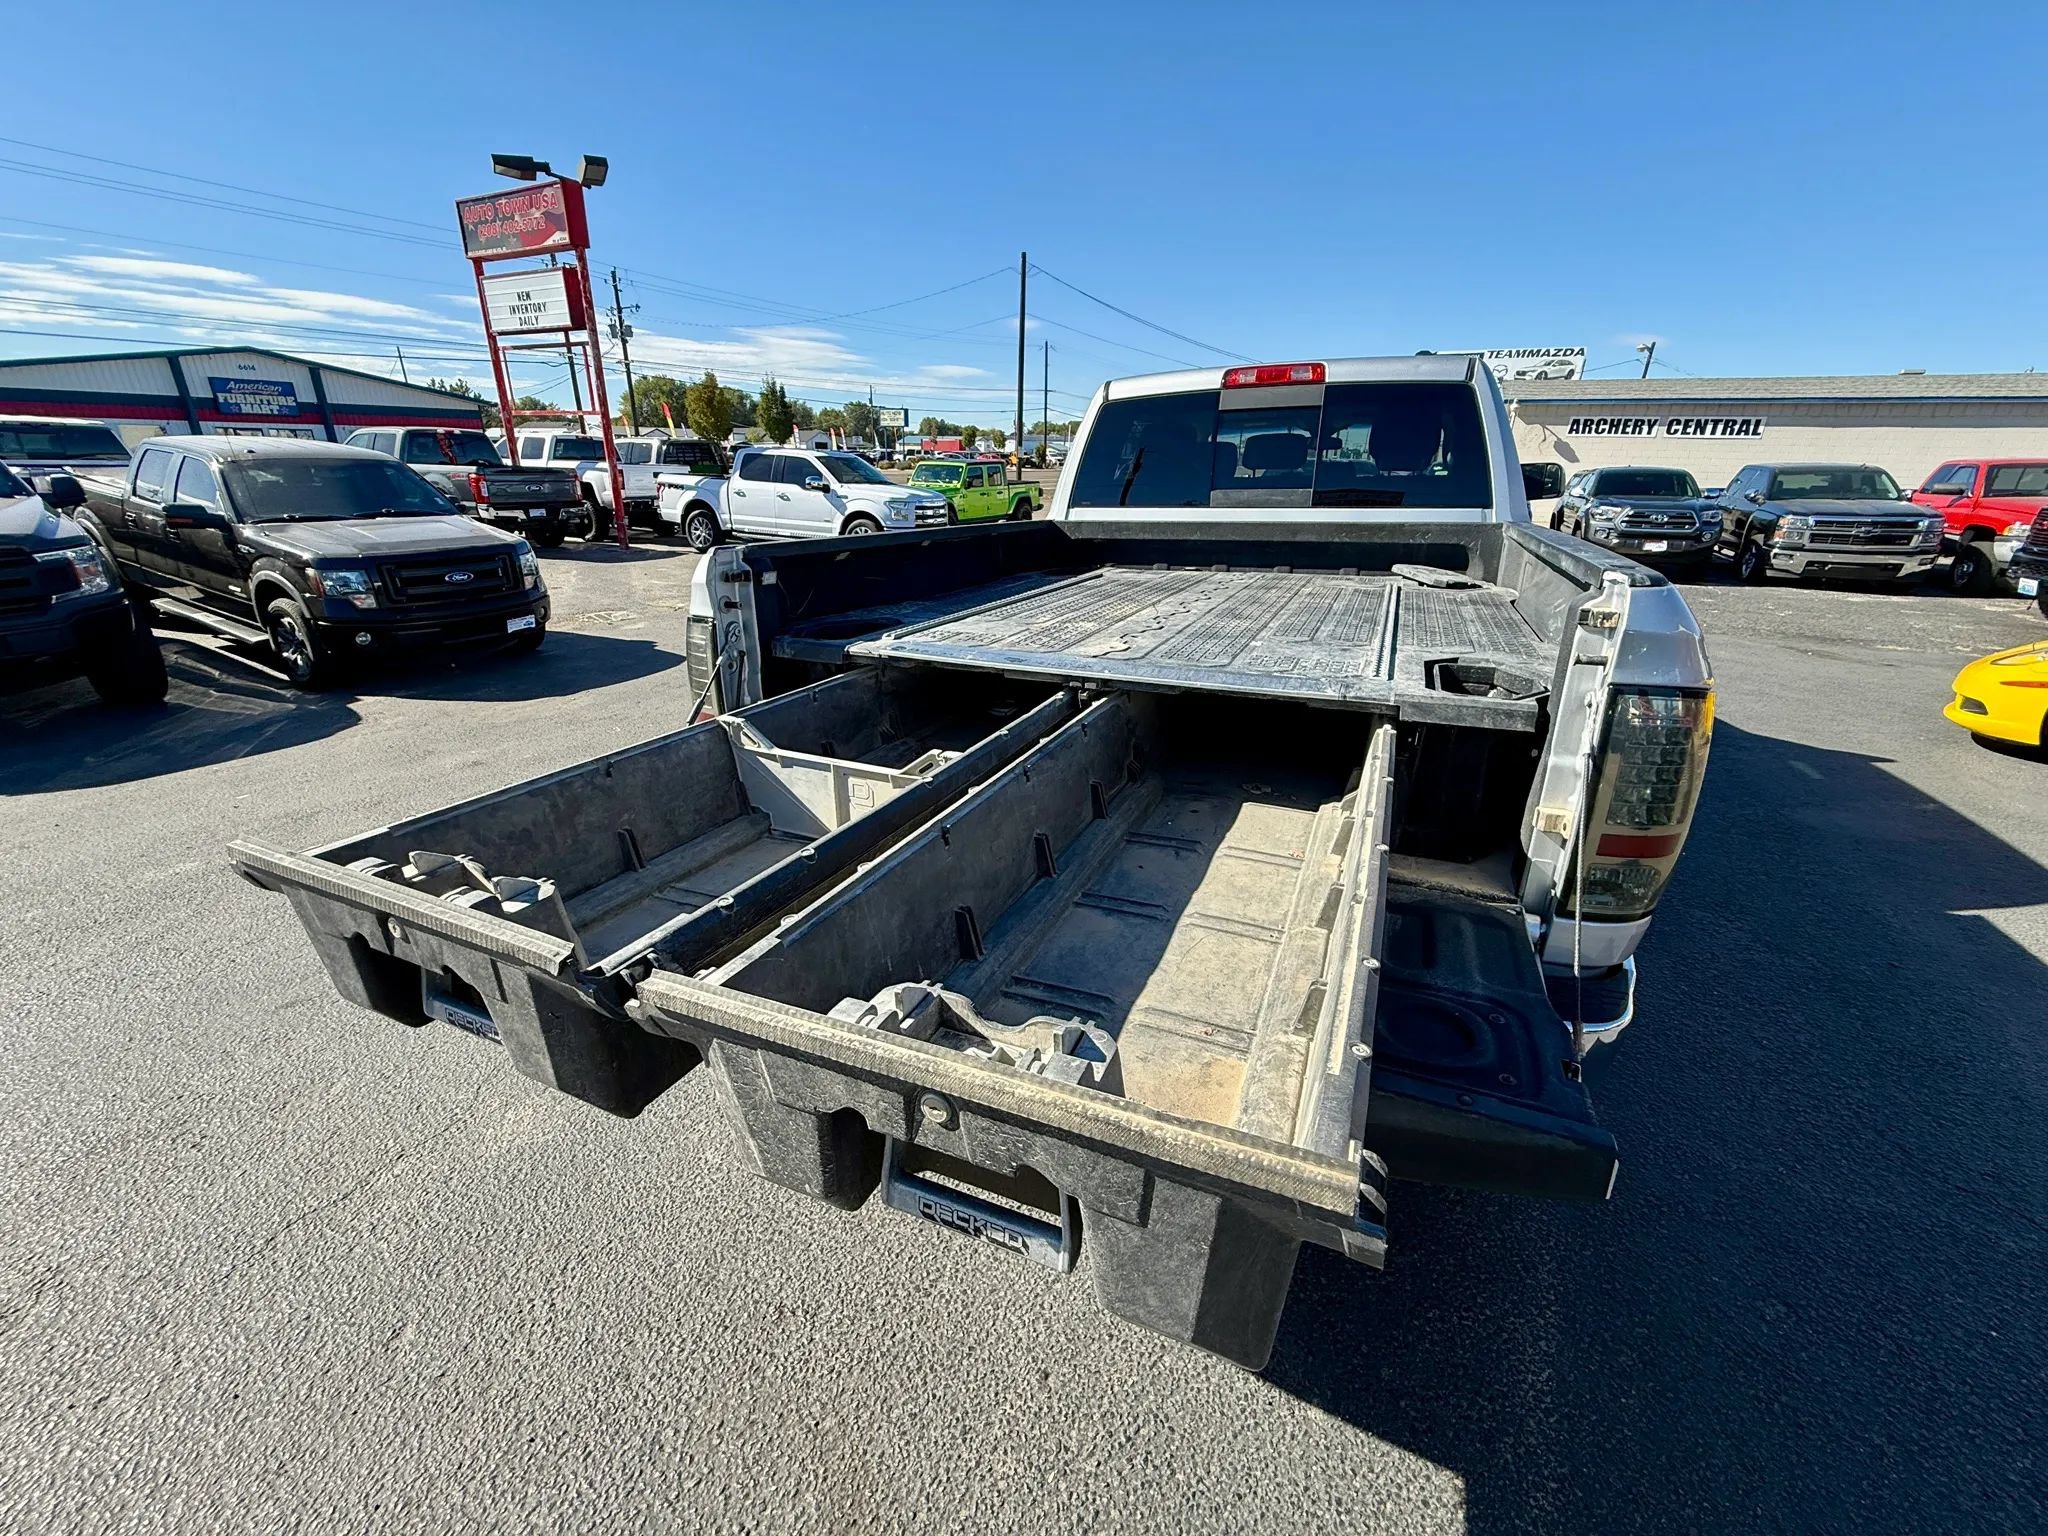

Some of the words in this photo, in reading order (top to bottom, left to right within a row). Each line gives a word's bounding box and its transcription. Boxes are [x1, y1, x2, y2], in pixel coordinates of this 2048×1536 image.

[464, 203, 494, 223] AUTO
[496, 196, 530, 217] TOWN
[532, 191, 558, 210] USA
[509, 302, 546, 315] INVENTORY
[519, 315, 538, 326] DAILY
[226, 381, 282, 392] American
[216, 393, 296, 406] FURNITURE
[240, 404, 280, 414] MART
[1568, 418, 1659, 435] ARCHERY
[1665, 418, 1762, 436] CENTRAL
